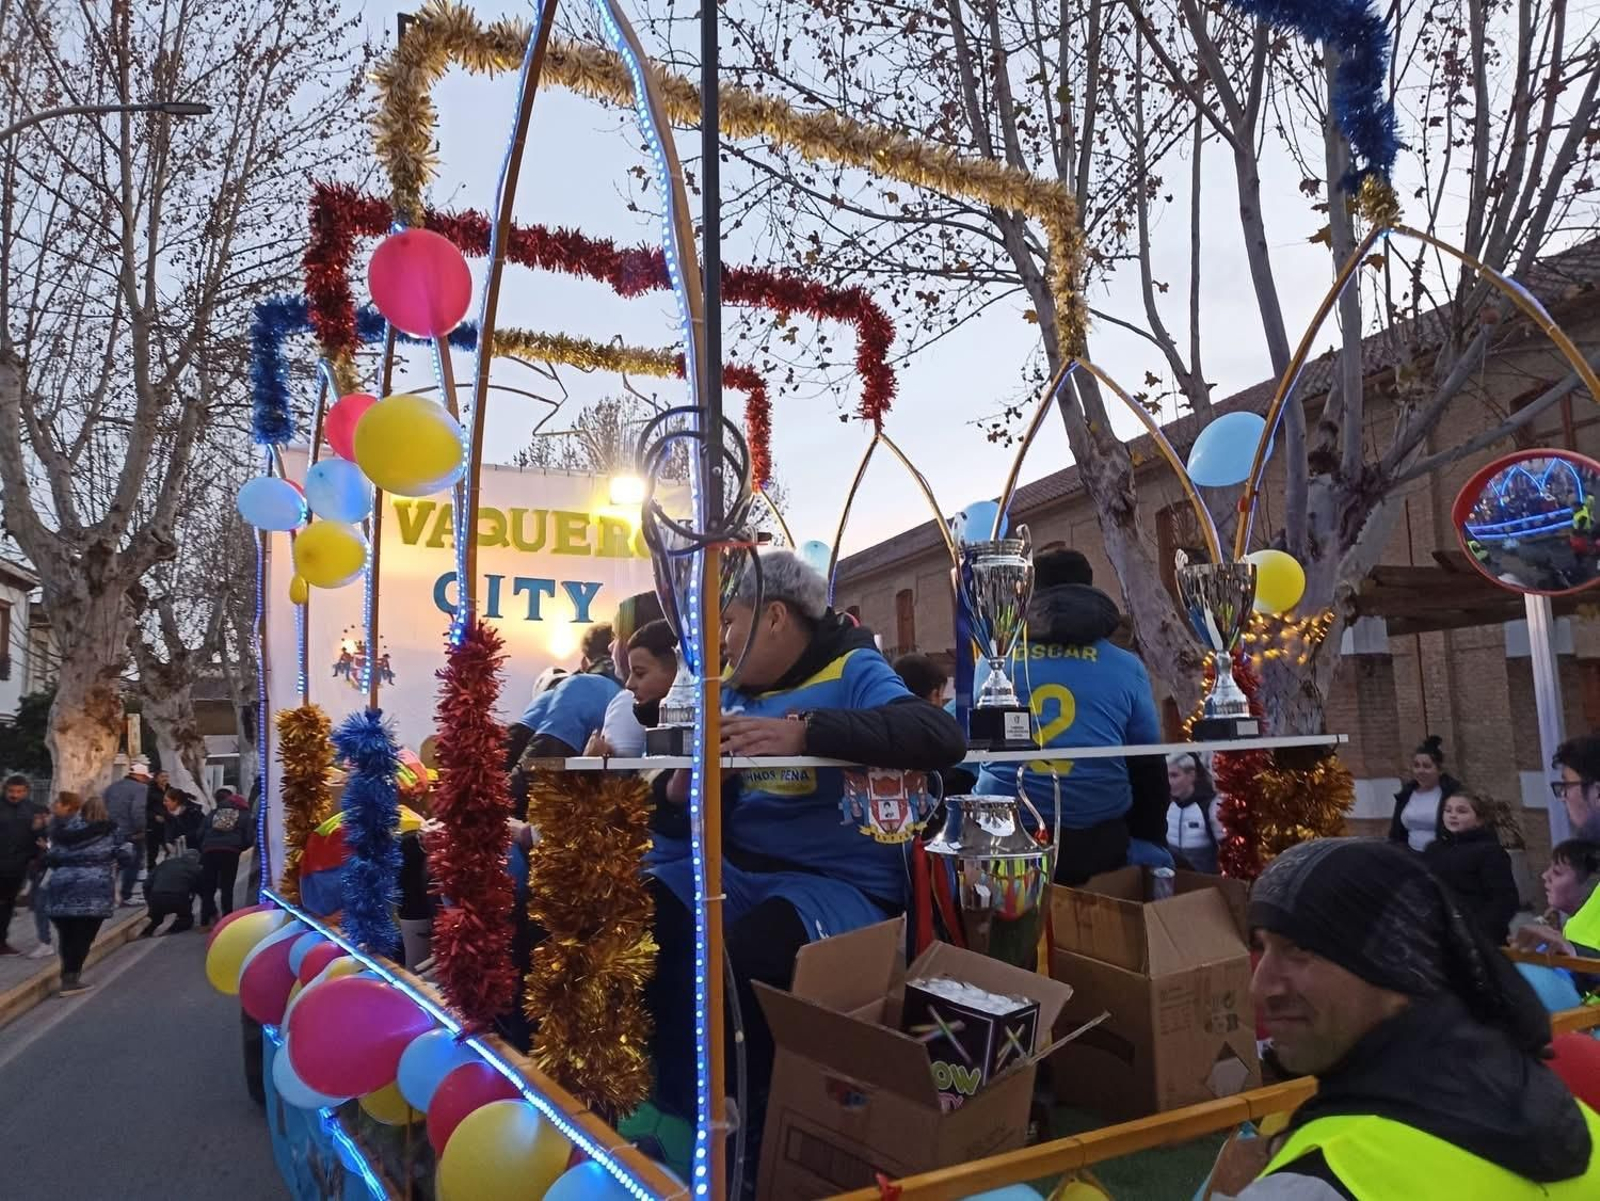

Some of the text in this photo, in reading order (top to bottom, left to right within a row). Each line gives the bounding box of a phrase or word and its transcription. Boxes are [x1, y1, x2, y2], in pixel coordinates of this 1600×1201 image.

[433, 571, 604, 623] CITY
[1028, 683, 1076, 775] 2
[930, 1060, 982, 1096] OW
